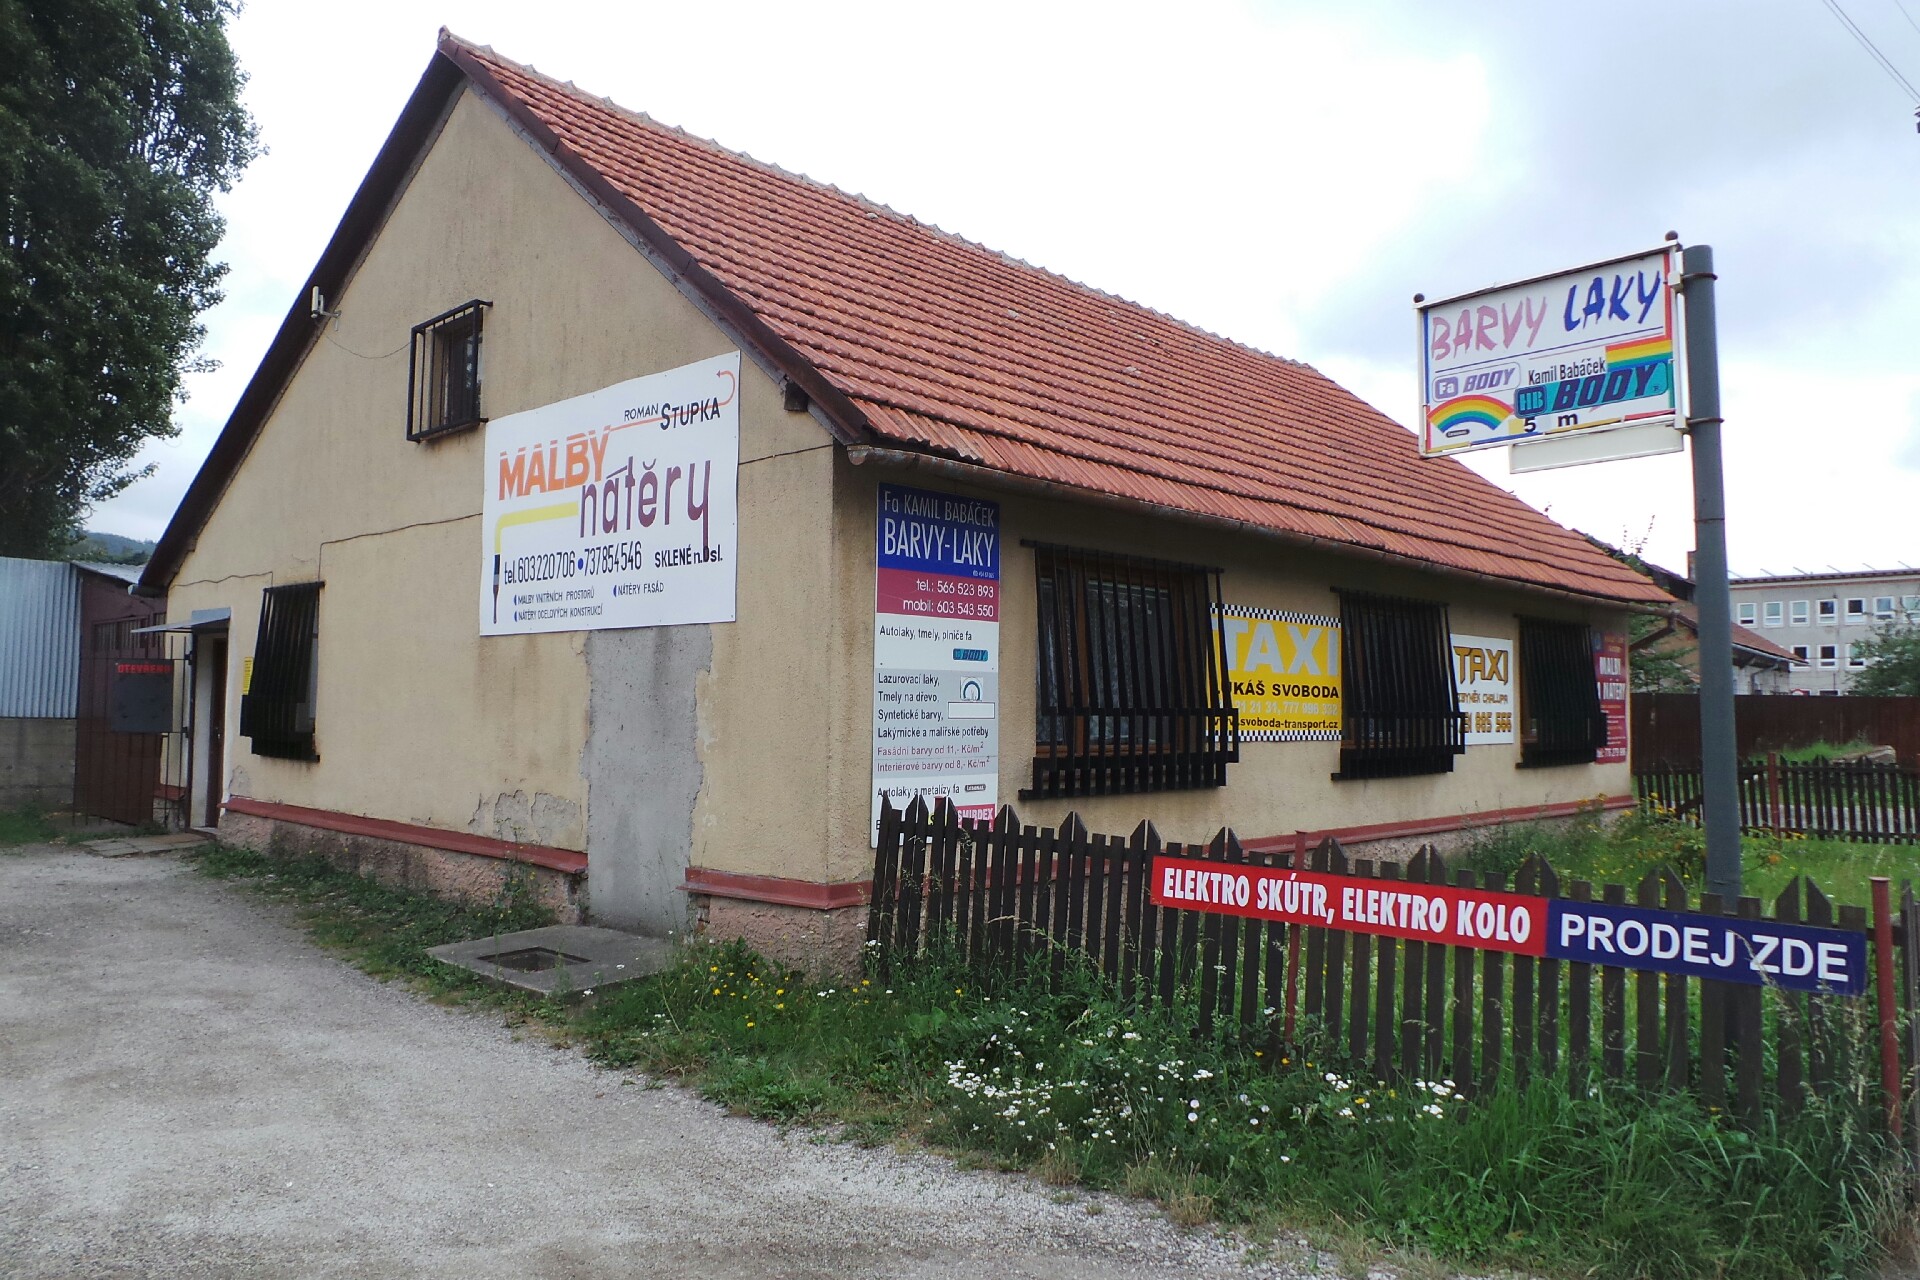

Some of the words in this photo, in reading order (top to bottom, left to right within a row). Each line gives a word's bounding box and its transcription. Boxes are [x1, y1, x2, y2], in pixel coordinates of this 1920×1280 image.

[1431, 297, 1547, 361] BARVY
[1563, 270, 1661, 332] LAKY
[1439, 381, 1455, 395] Fa
[1462, 367, 1516, 393] BODY
[1528, 365, 1557, 385] Kamil
[1560, 357, 1606, 380] Babáček
[1518, 390, 1544, 411] HB
[1551, 361, 1658, 411] BODY
[623, 402, 660, 422] ROMAN
[660, 397, 721, 431] STUPKA
[1557, 413, 1578, 427] m
[498, 424, 611, 501] MALBY
[580, 455, 712, 554] nátěry
[884, 490, 899, 514] Fa
[904, 494, 941, 521] KAMIL
[944, 501, 995, 529] BABÁČEK
[884, 517, 995, 568] BARVY-LAKY
[654, 543, 692, 569] SKLENÉ
[517, 594, 535, 605] MALBY
[566, 585, 595, 600] PROSTORŮ
[643, 580, 665, 594] FASÁD
[916, 578, 934, 592] tel.:
[936, 580, 955, 594] 566
[957, 582, 975, 596] 523
[977, 584, 994, 598] 893
[902, 598, 934, 613] mobil:
[936, 600, 955, 614] 603
[957, 602, 975, 616] 543
[977, 604, 994, 618] 550
[879, 625, 916, 640] Autolaky,
[918, 628, 940, 641] tmely,
[942, 629, 964, 641] plniče
[965, 630, 972, 641] fa
[961, 649, 987, 662] BODY
[1211, 617, 1339, 676] TAXI
[1453, 645, 1508, 686] TAXI
[878, 672, 922, 685] Lazurovací
[923, 673, 940, 687] laky,
[878, 690, 902, 705] Tmely
[904, 693, 914, 702] na
[1271, 683, 1340, 699] SVOBODA
[877, 708, 919, 722] Syntetické
[920, 709, 944, 722] barvy,
[877, 726, 921, 741] Lakýrnické
[922, 729, 927, 737] a
[928, 726, 960, 738] malířské
[961, 725, 989, 739] potřeby
[877, 745, 909, 757] Fasádní
[911, 745, 933, 757] barvy
[934, 745, 945, 755] od
[877, 761, 920, 772] Interiérové
[921, 761, 944, 772] barvy
[944, 760, 955, 770] od
[920, 784, 951, 797] metalízy
[952, 784, 960, 794] fa
[1163, 867, 1250, 907] ELEKTRO
[1257, 872, 1335, 925] SKÚTR,
[1342, 887, 1448, 933] ELEKTRO
[1457, 900, 1531, 944] KOLO
[1560, 912, 1736, 967] PRODEJ
[1749, 934, 1849, 983] ZDE
